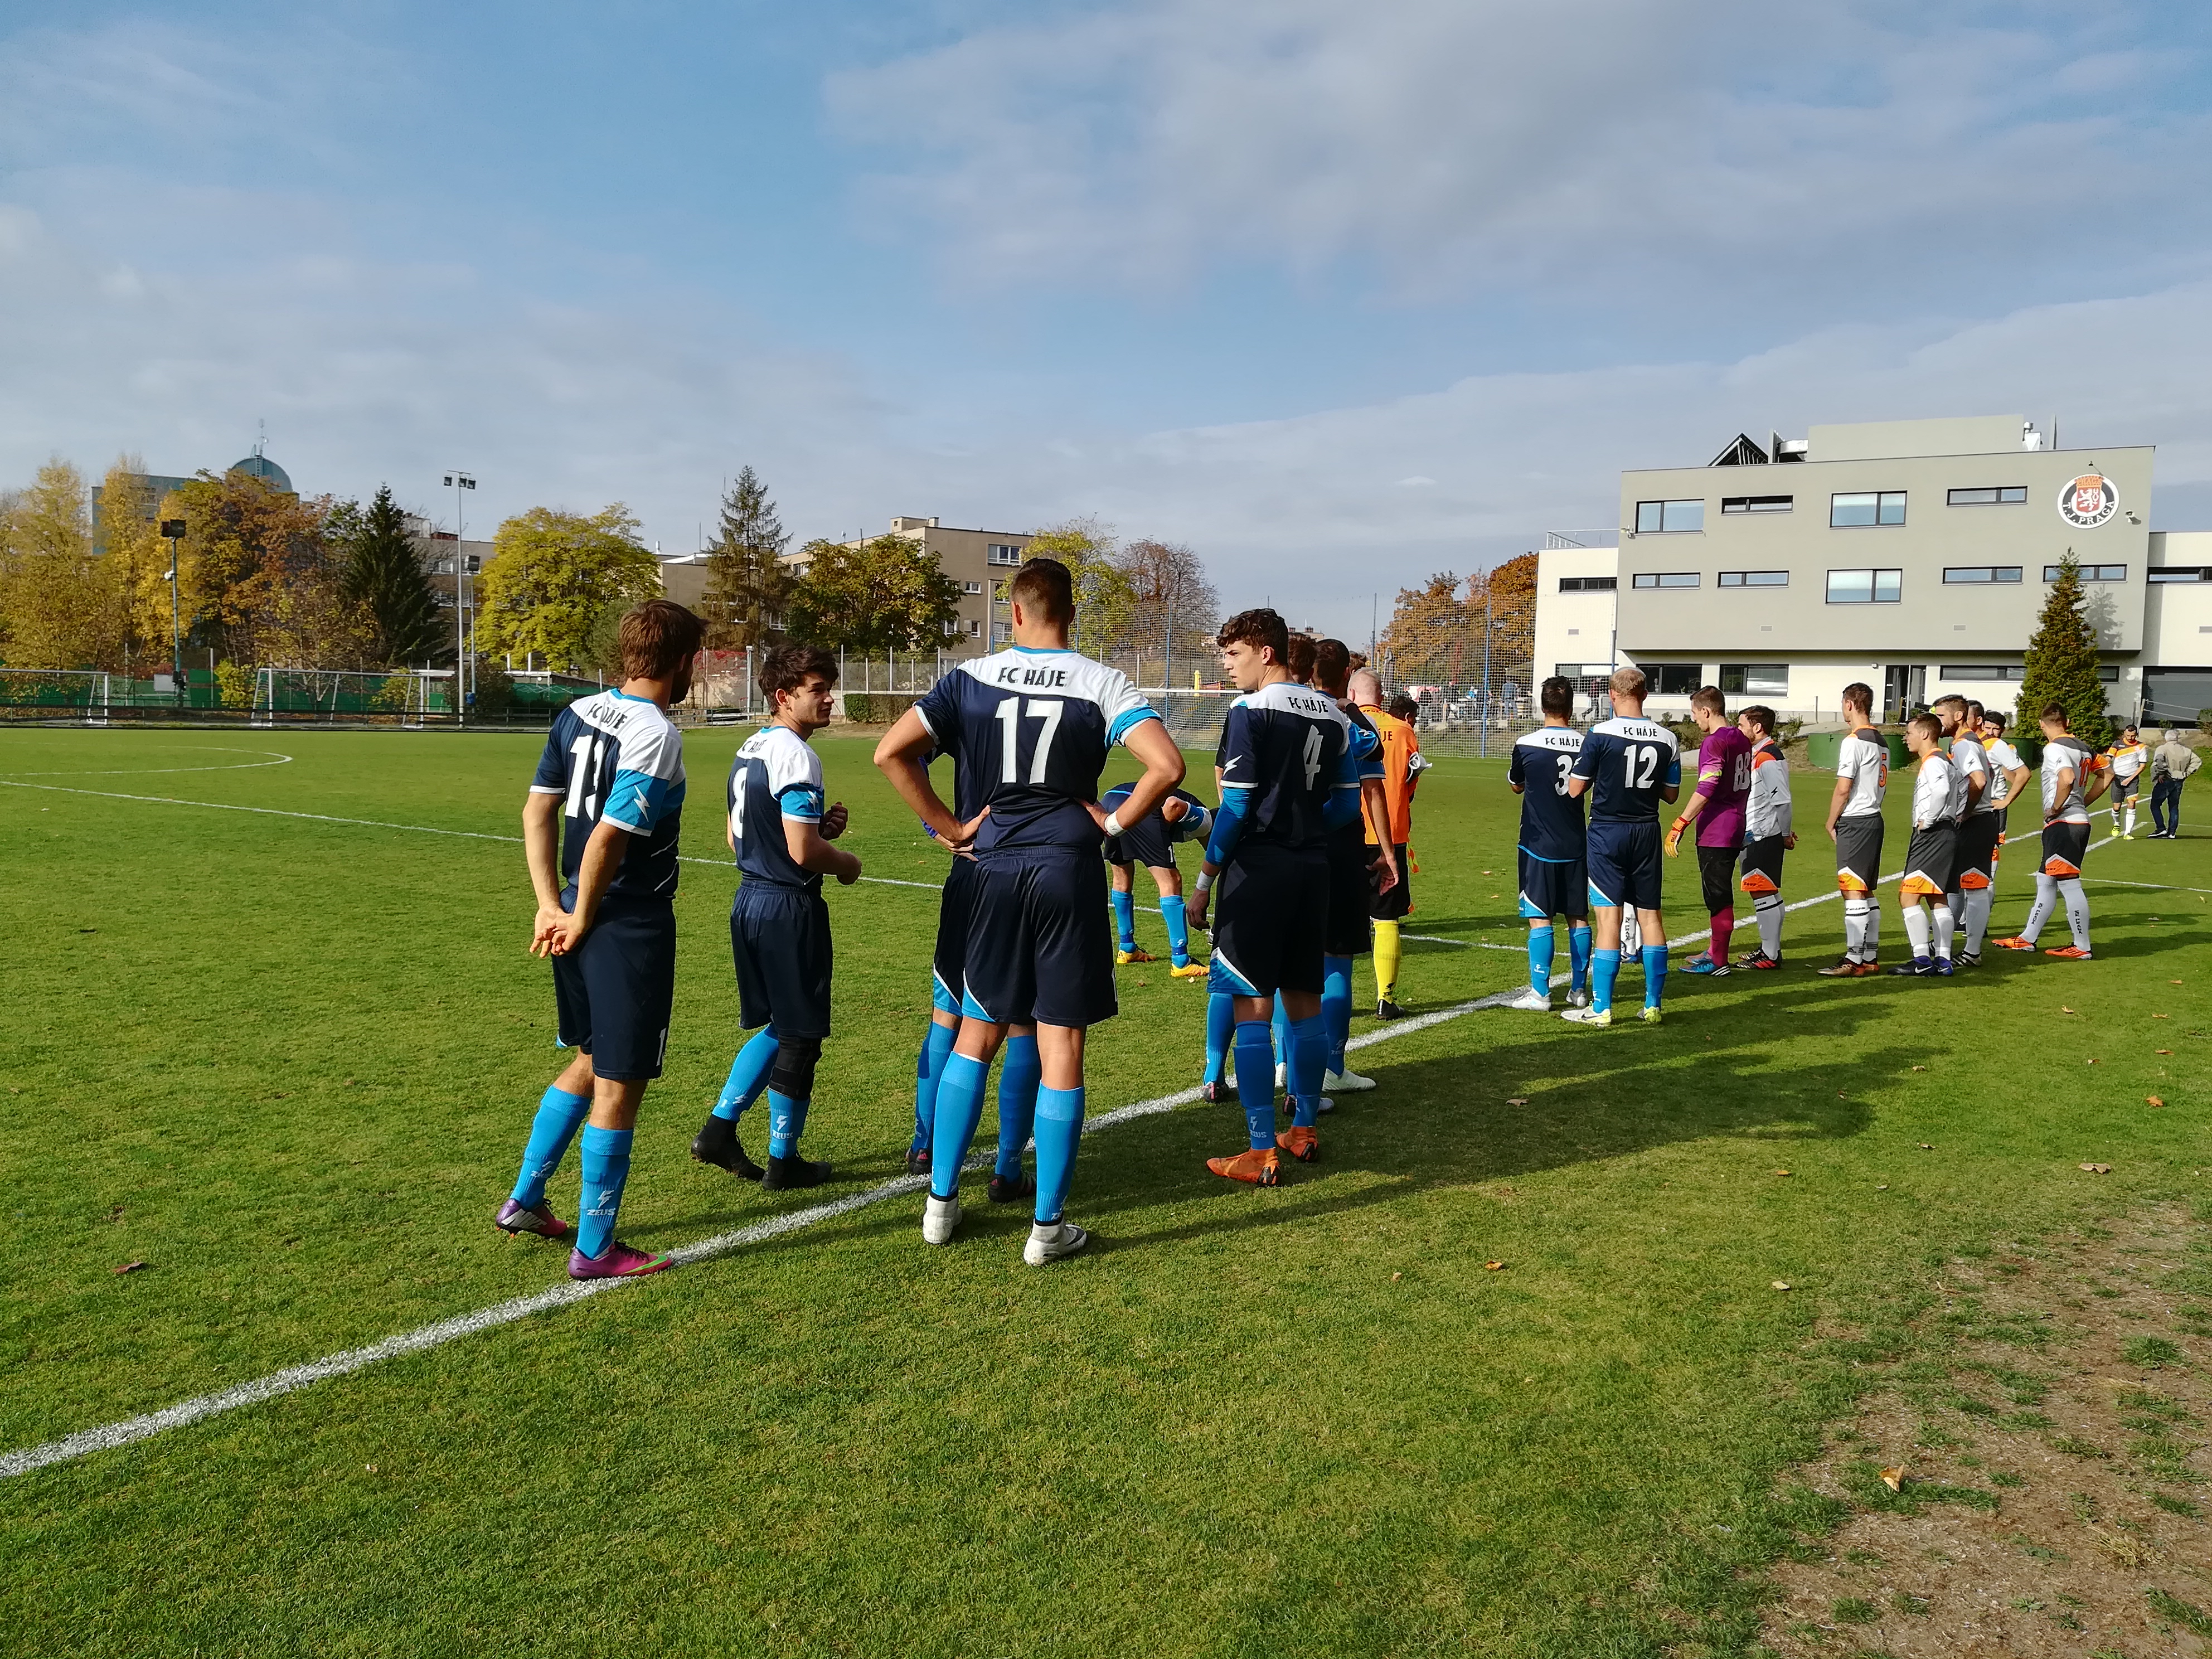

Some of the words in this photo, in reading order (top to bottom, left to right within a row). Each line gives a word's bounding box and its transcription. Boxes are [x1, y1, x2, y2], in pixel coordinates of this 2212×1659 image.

[997, 667, 1020, 684] FC
[1023, 666, 1067, 688] HÁJE
[1288, 696, 1302, 710] FC
[1302, 696, 1328, 714] HÁJE
[995, 696, 1064, 784] 17
[1545, 737, 1556, 745] FC
[1559, 736, 1580, 747] HÁJE
[1623, 727, 1633, 736] FC
[1636, 726, 1658, 737] HÁJE
[1303, 725, 1324, 791] 4
[1623, 744, 1658, 789] 12
[1555, 754, 1573, 796] 3
[587, 1207, 616, 1216] ZEUS
